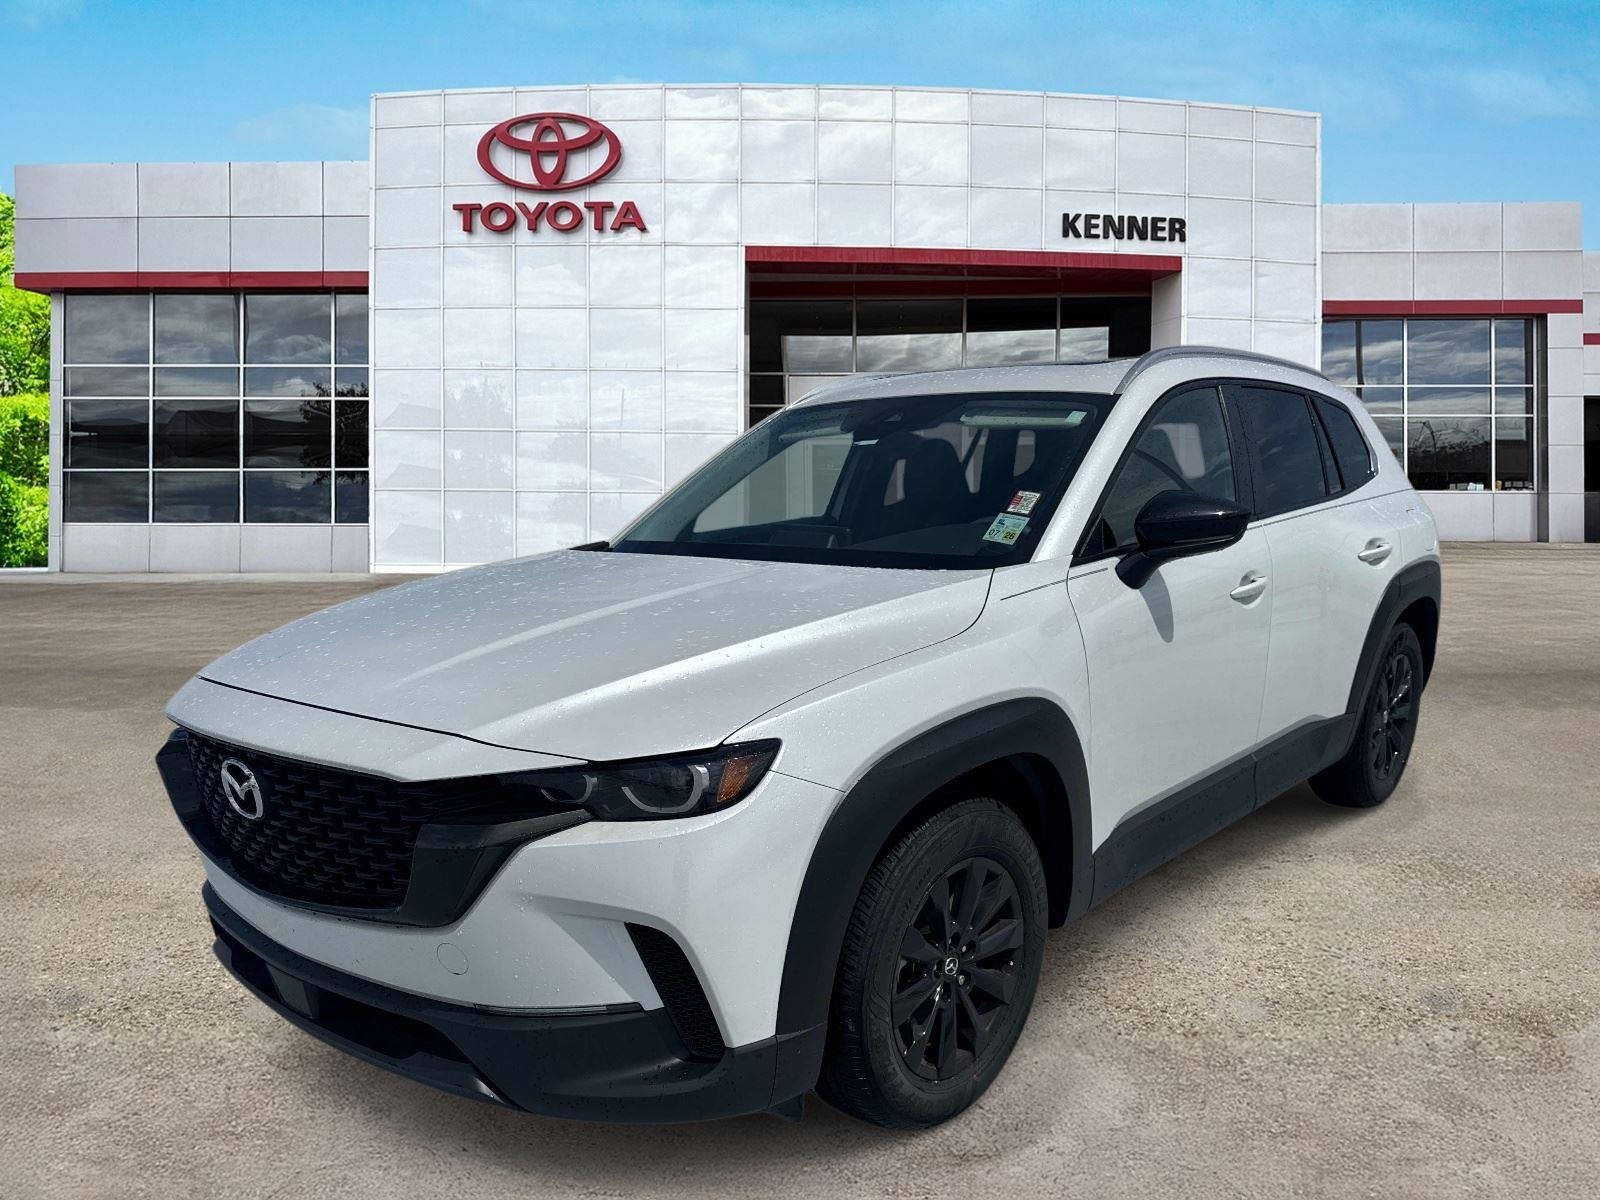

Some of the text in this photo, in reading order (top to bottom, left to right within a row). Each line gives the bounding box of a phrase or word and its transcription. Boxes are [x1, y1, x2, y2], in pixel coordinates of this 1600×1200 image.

[453, 201, 647, 232] TOYOTA
[1062, 213, 1187, 242] KENNER
[988, 529, 1015, 540] 07 26
